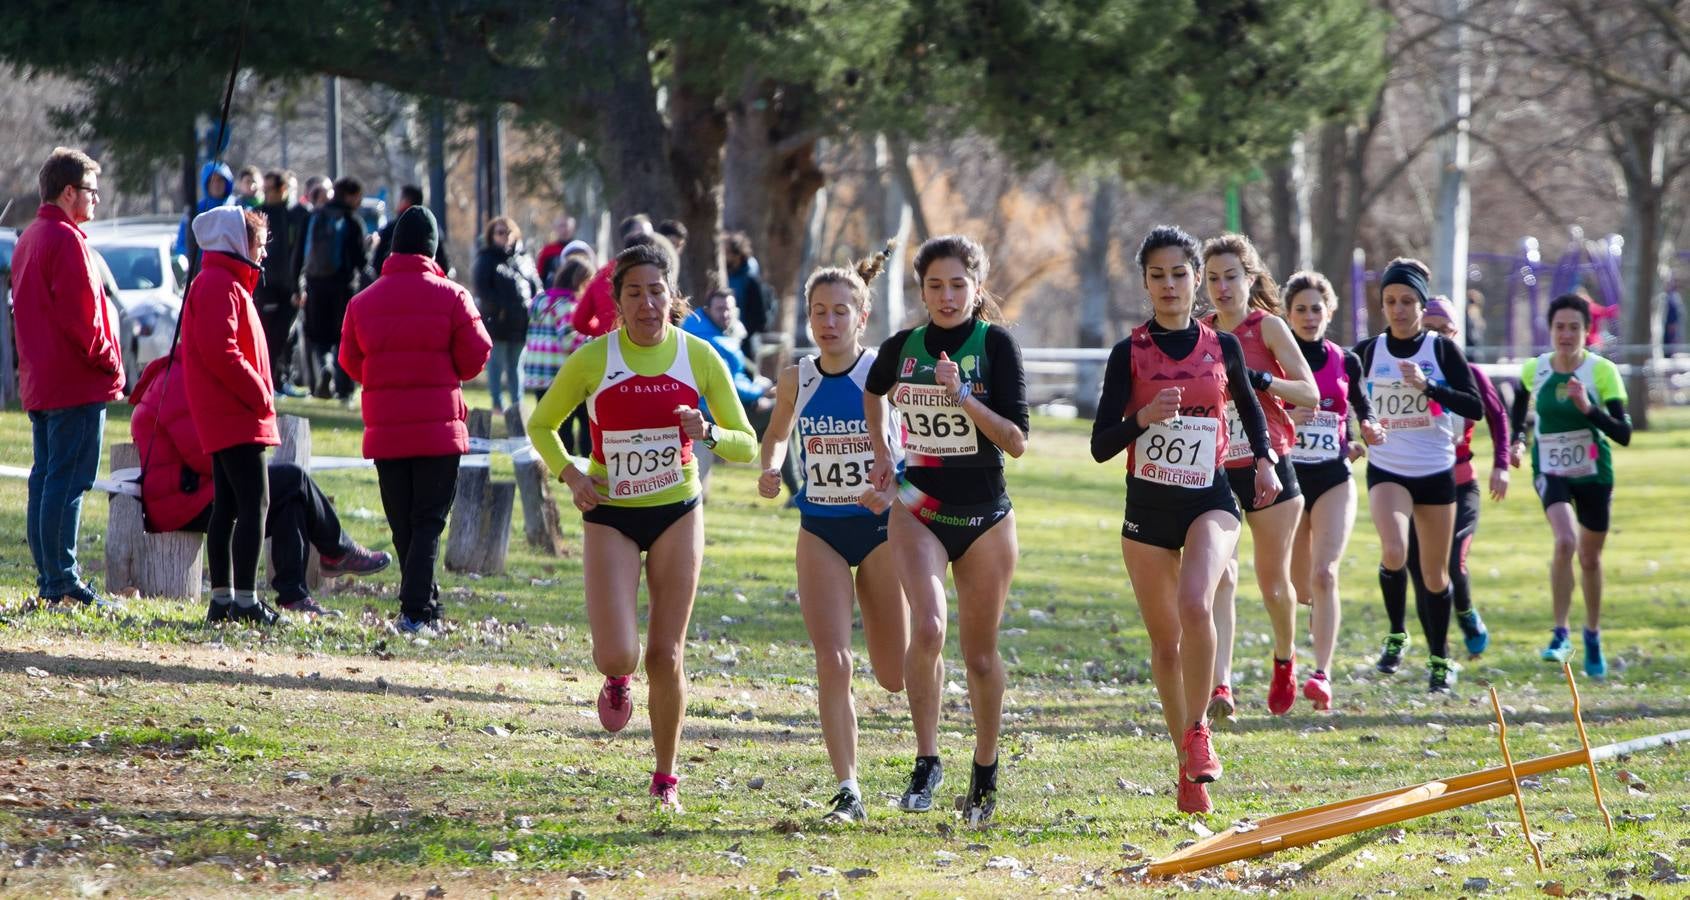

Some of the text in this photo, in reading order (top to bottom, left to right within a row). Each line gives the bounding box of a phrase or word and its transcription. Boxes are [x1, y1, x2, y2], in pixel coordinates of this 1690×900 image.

[620, 382, 680, 393] O BARCO
[1375, 393, 1430, 415] 1020
[902, 411, 970, 438] 1363
[1201, 425, 1216, 433] Rioja
[610, 446, 677, 476] 1039
[1146, 434, 1202, 466] 861
[1549, 444, 1585, 467] 560
[633, 472, 679, 494] ATLETISMO
[810, 459, 875, 488] 1435
[1157, 470, 1206, 487] ATLETISMO
[920, 507, 984, 527] BidezabalAT
